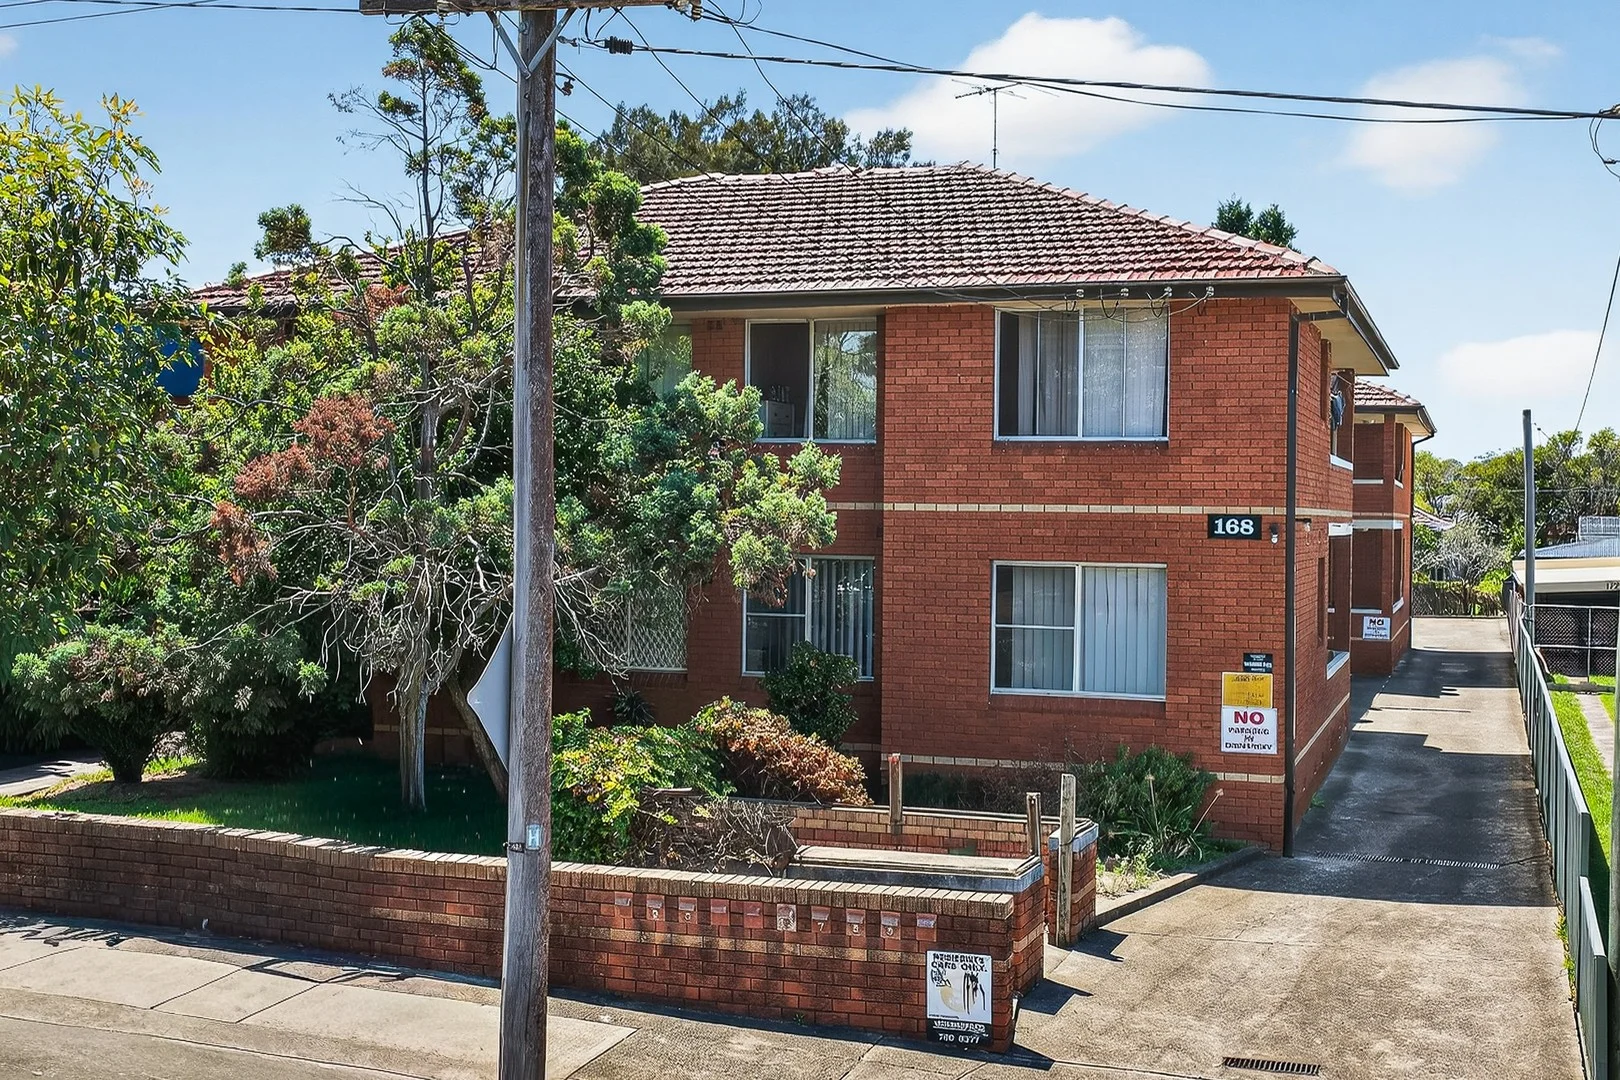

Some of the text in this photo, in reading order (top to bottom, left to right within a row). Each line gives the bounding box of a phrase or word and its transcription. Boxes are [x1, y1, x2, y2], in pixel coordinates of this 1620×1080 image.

[1214, 518, 1254, 535] 168
[1234, 711, 1265, 725] NO
[817, 922, 824, 931] 7
